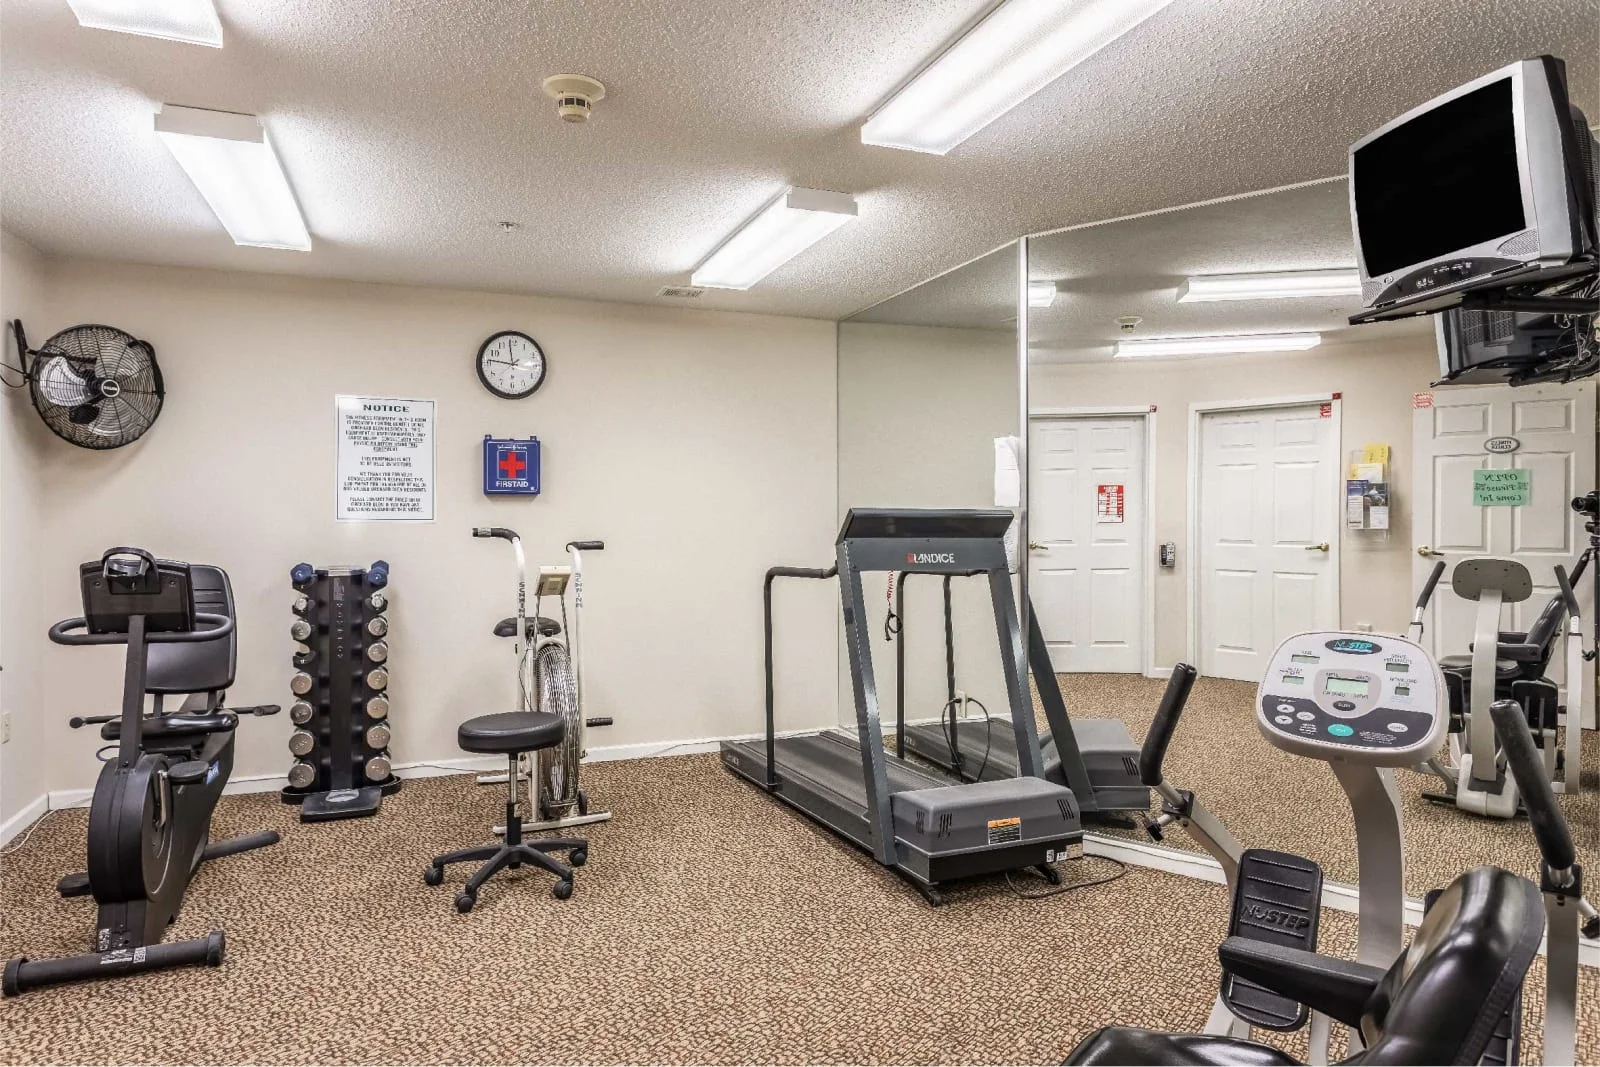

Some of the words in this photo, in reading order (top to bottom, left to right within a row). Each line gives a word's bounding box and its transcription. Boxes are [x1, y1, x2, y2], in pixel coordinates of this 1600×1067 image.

[363, 404, 410, 413] NOTICE
[914, 552, 955, 564] LANDICE
[1241, 904, 1311, 930] NUSTEP
